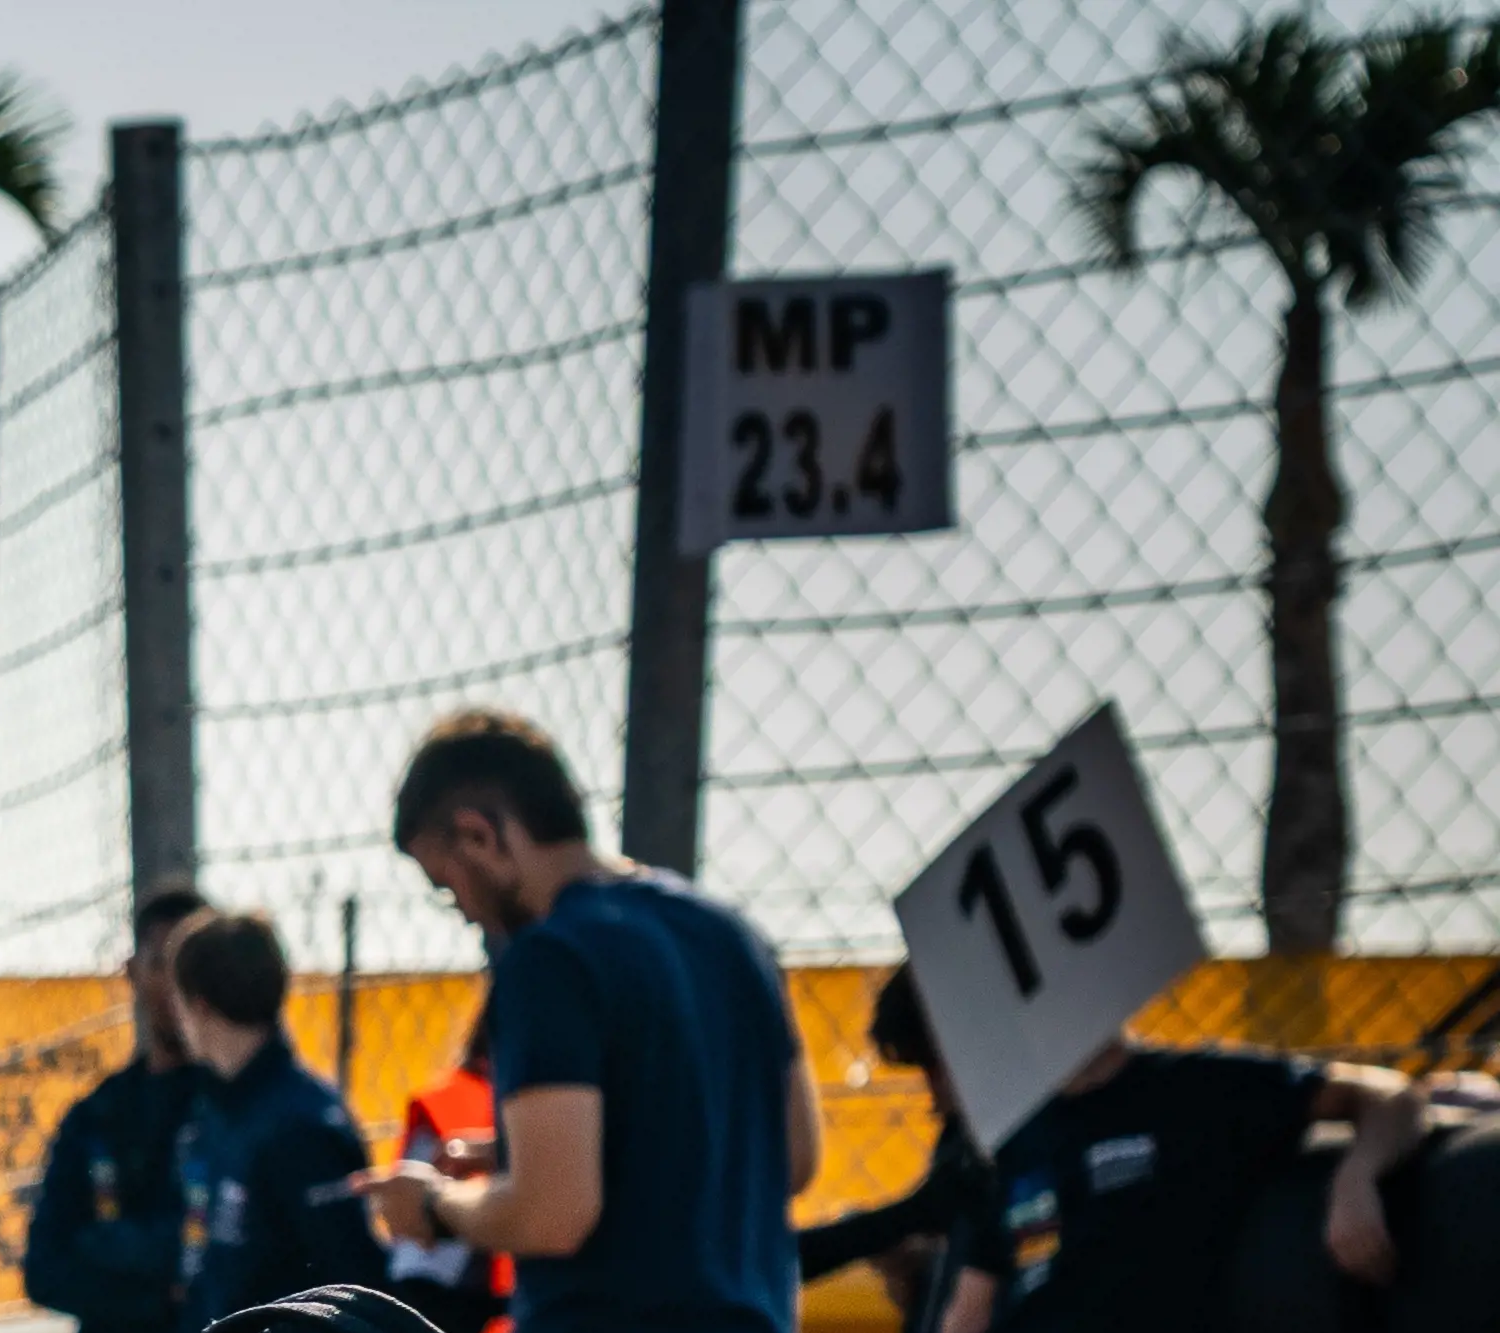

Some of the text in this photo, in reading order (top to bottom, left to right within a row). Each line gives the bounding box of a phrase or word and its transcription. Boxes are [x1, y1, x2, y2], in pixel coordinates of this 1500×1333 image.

[734, 294, 891, 378] MP
[729, 407, 902, 522] 23.4
[955, 766, 1122, 1001] 15
